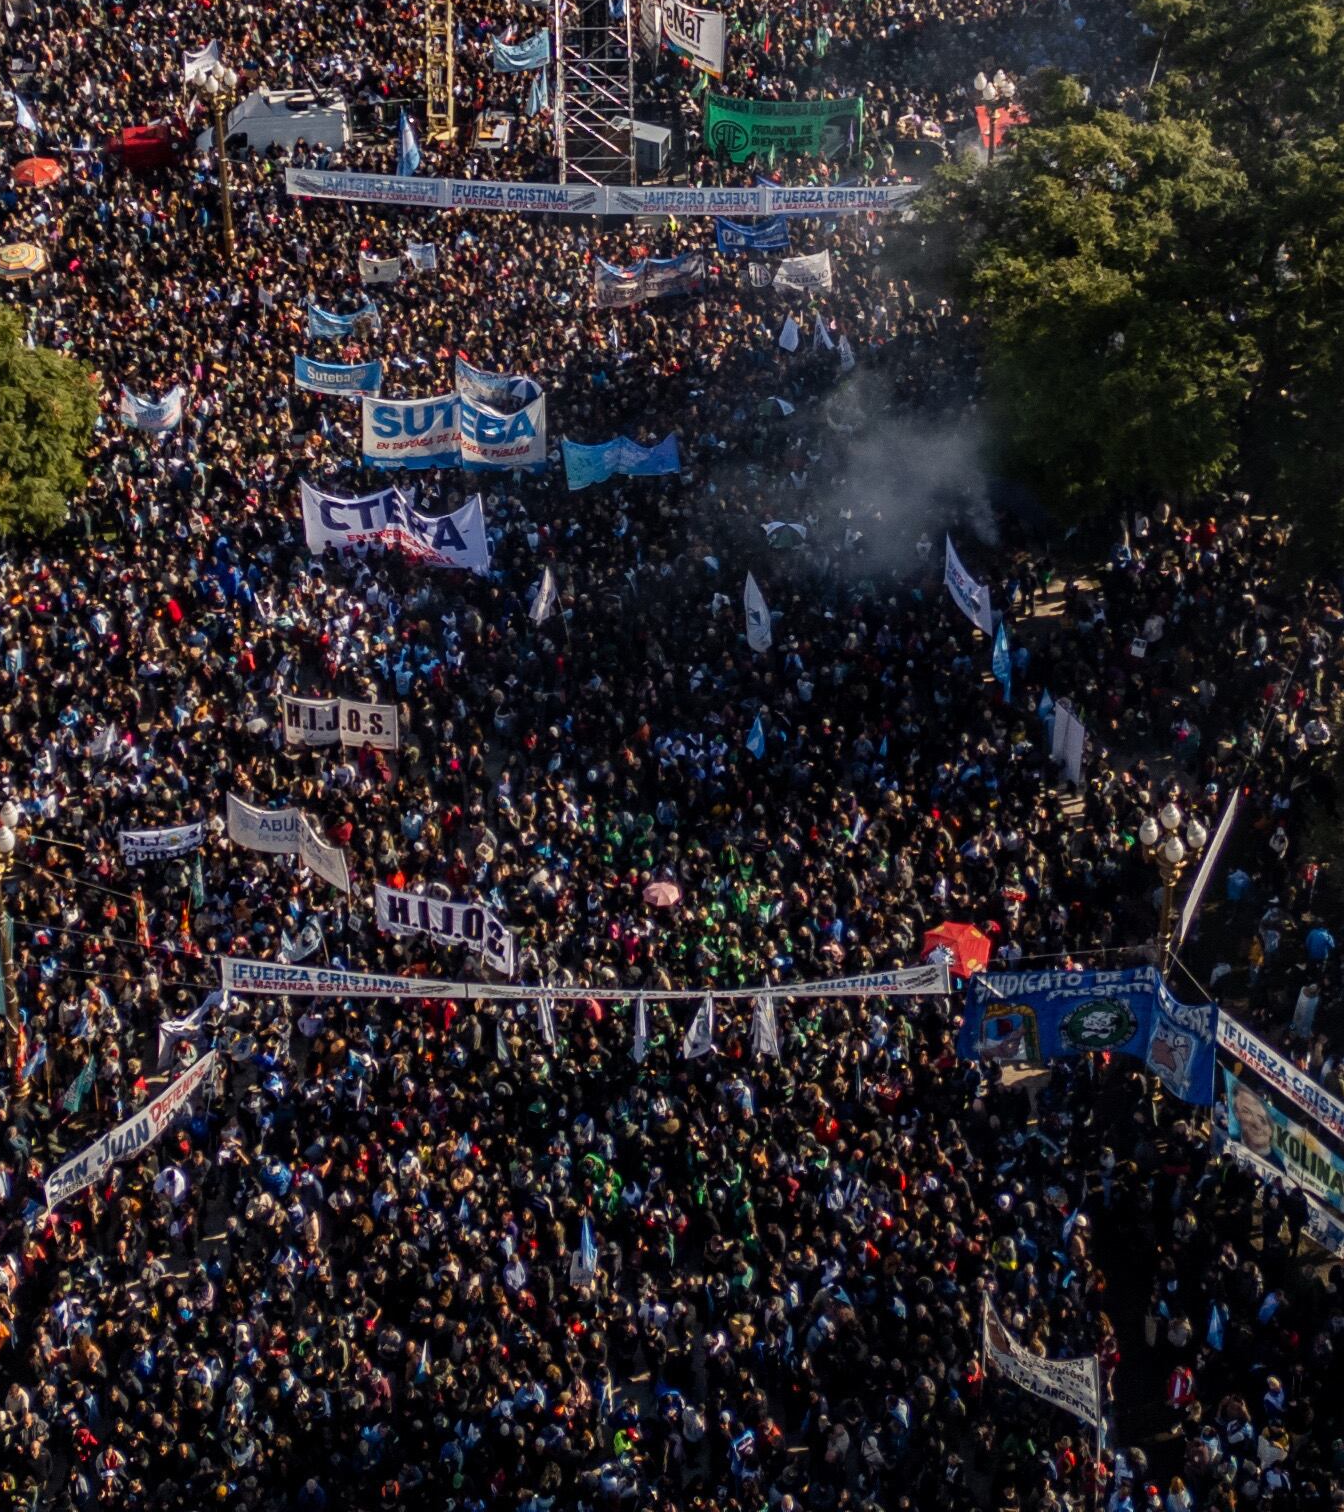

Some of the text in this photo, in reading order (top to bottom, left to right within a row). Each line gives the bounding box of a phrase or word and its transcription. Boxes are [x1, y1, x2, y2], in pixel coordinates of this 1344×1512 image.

[452, 182, 505, 200] ¡FUERZA
[507, 187, 569, 204] CRISTINA!
[464, 198, 507, 208] MATANZA
[827, 189, 890, 204] CRISTINA!
[307, 365, 352, 383] Suteba
[371, 397, 538, 445] SUTEBA
[232, 963, 411, 989] ¡FUERZA CRISTINA!
[232, 980, 253, 990] LA
[256, 980, 315, 991] MATANZA
[1095, 971, 1122, 985] DE
[1134, 966, 1155, 980] LA
[1223, 1021, 1288, 1084] ¡FUERZA
[1222, 1037, 1237, 1051] LA
[1237, 1048, 1290, 1093] MATANZA
[50, 1158, 89, 1188] SAN
[97, 1117, 150, 1166] JUAN
[1274, 1124, 1344, 1193] KOLINA
